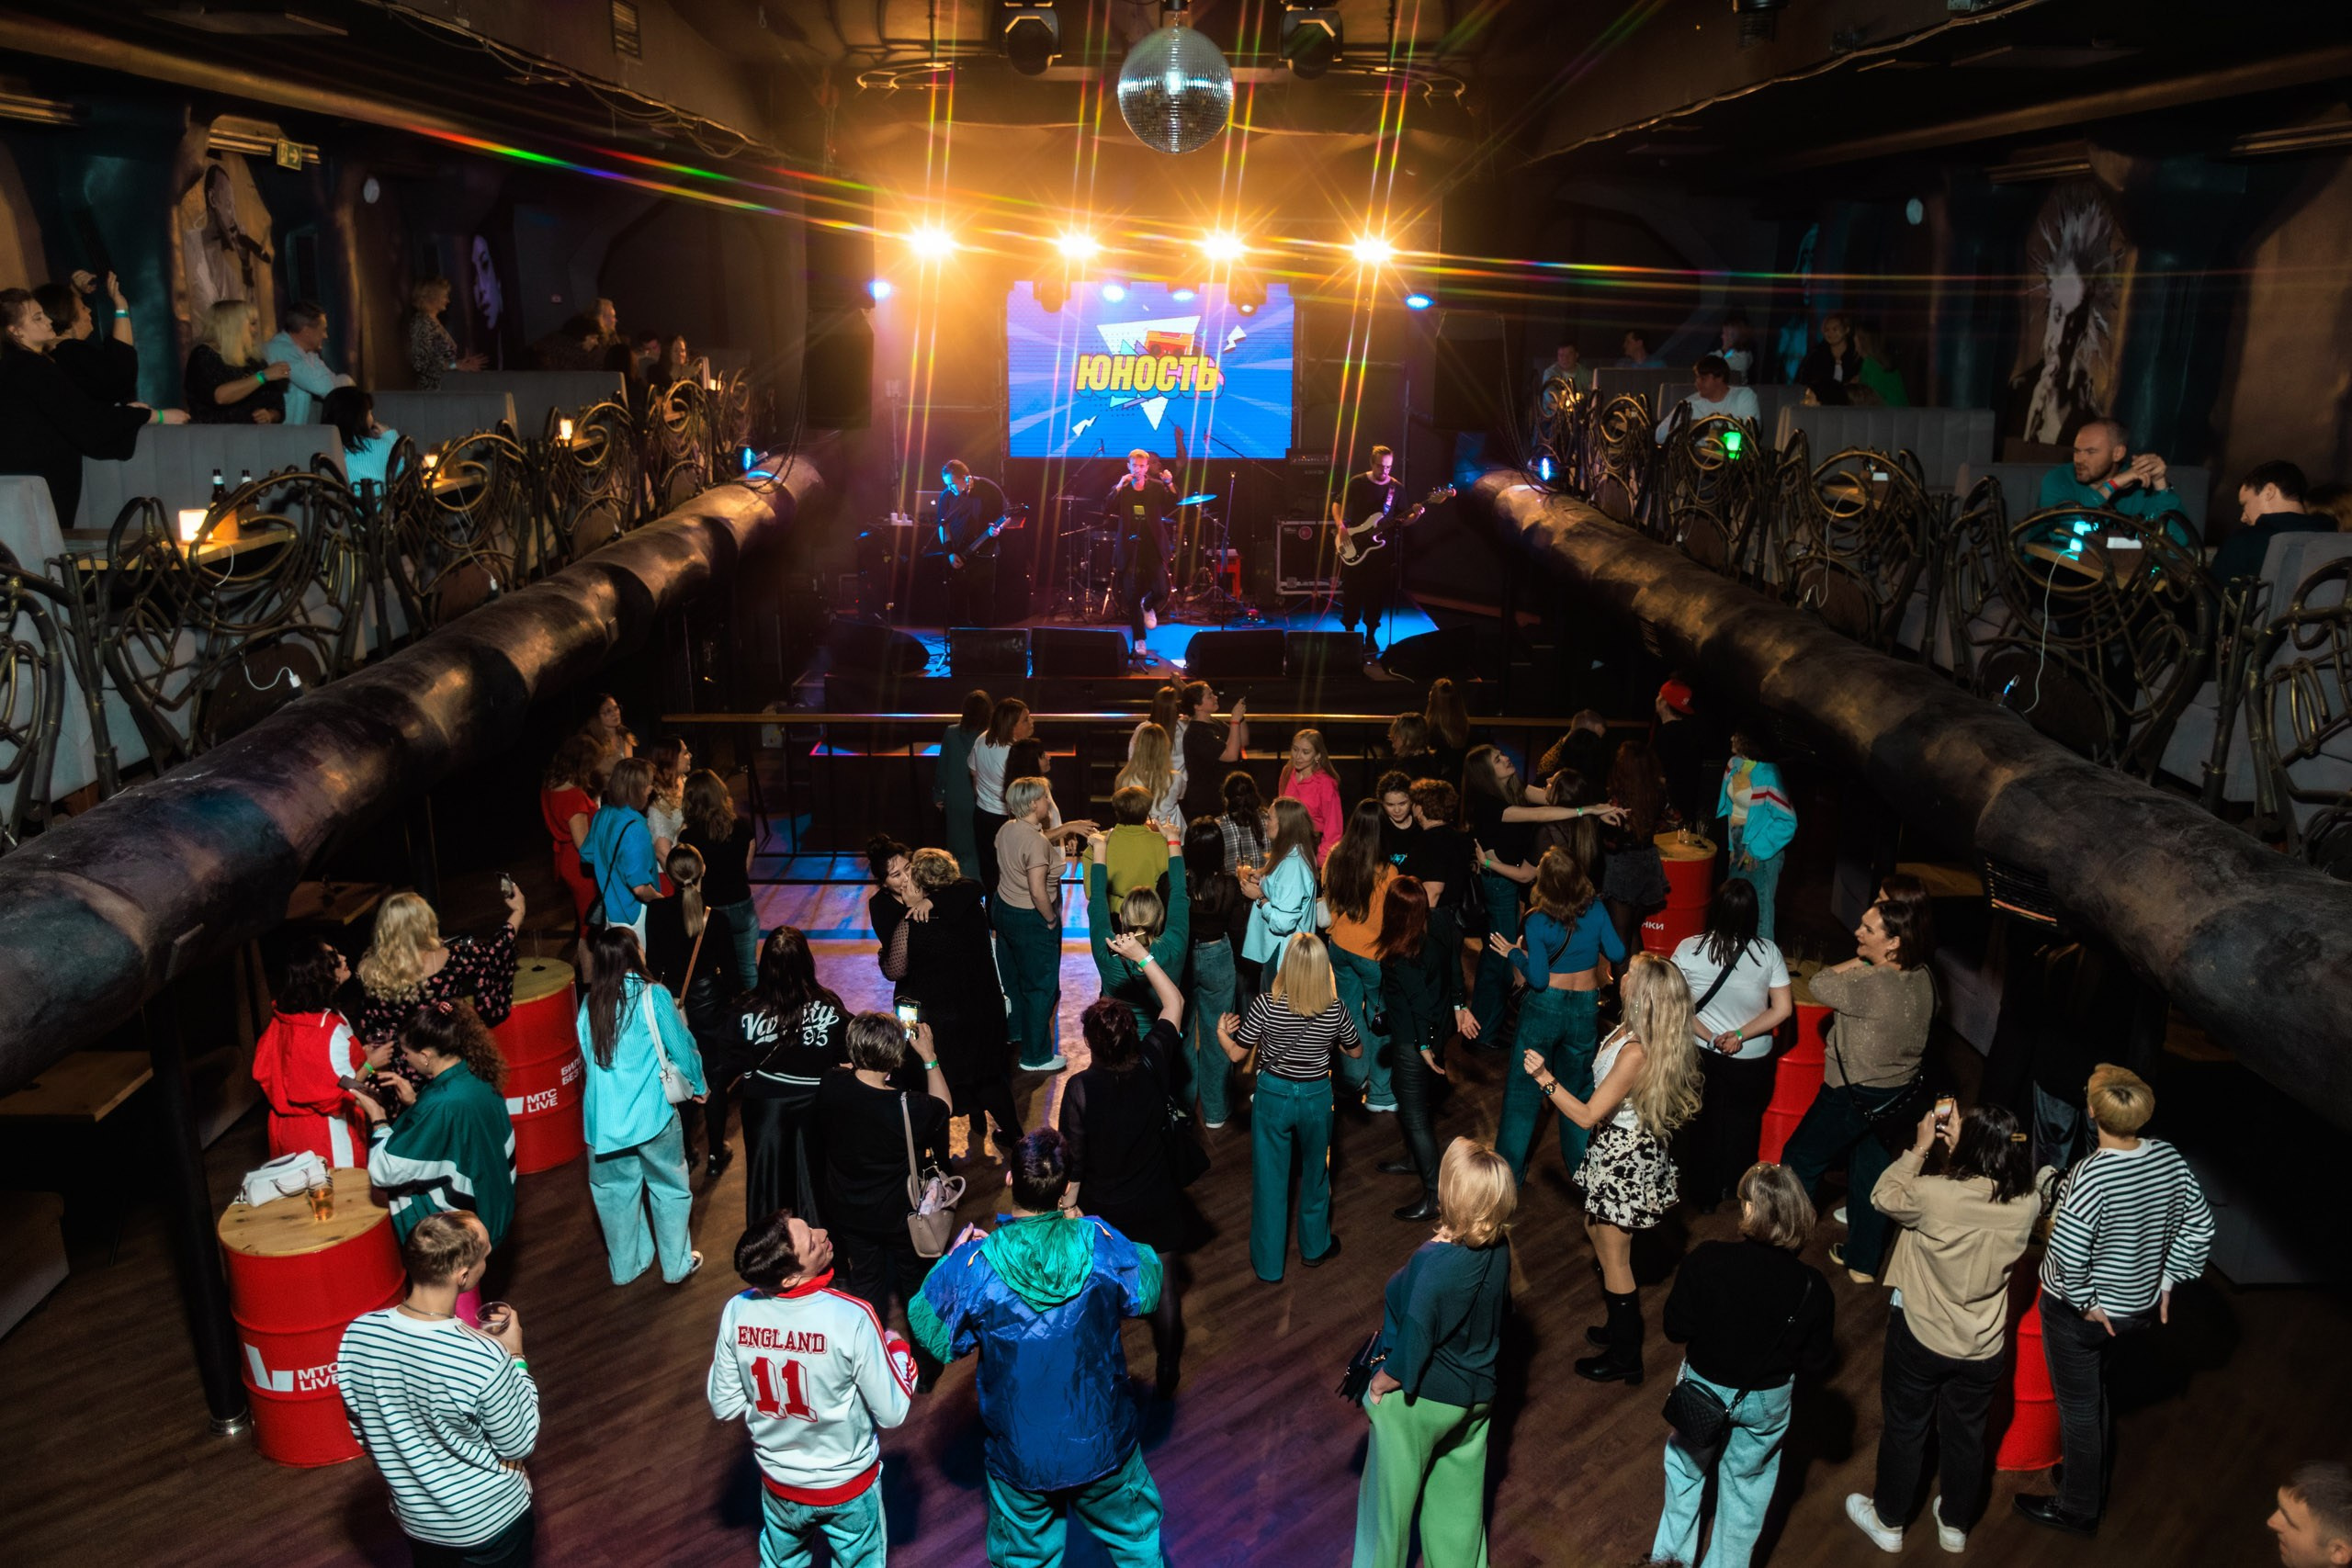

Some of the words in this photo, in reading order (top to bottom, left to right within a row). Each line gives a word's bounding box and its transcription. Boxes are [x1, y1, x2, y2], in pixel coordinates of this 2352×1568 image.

[1075, 355, 1221, 394] ЮНОСТЬ
[802, 1028, 829, 1047] 95
[526, 1088, 558, 1104] МТС
[527, 1096, 559, 1113] LIVE
[738, 1325, 828, 1355] ENGLAND
[751, 1356, 819, 1423] 11
